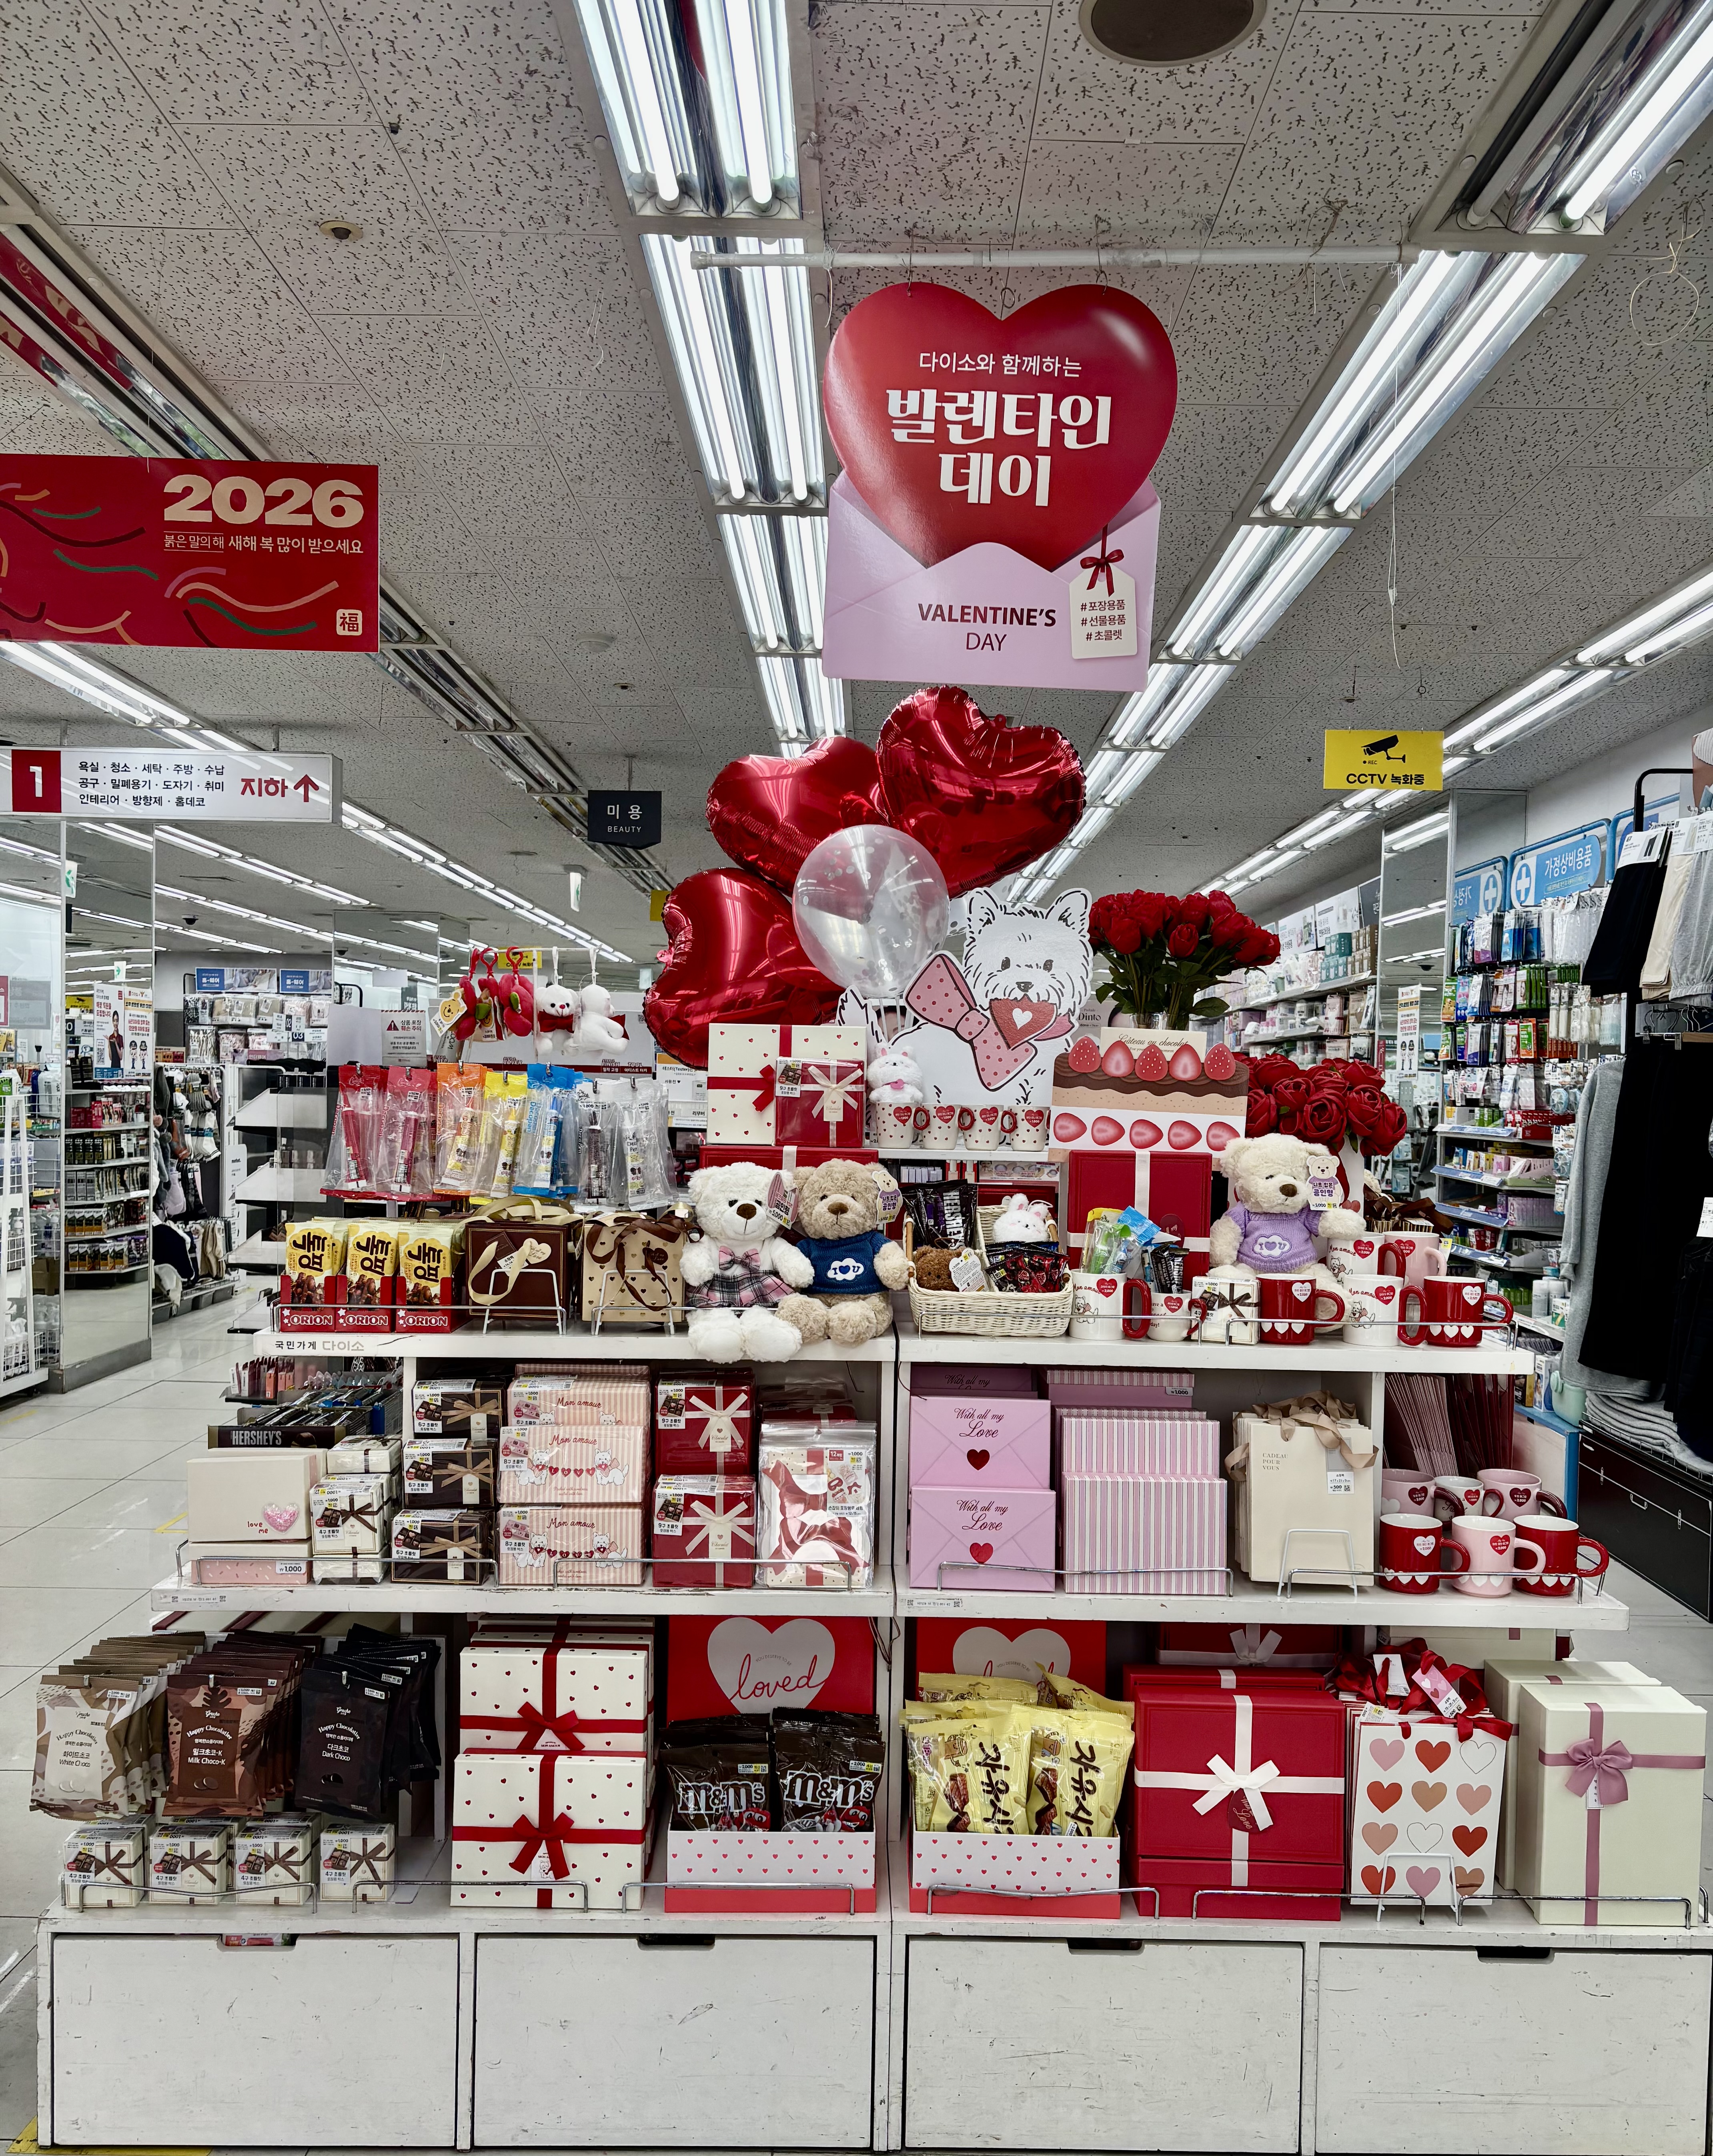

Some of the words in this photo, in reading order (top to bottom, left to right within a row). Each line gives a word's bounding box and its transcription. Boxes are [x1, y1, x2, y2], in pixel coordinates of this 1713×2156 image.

[920, 353, 995, 374] 다이소와
[1002, 354, 1082, 377] 함께하는
[886, 388, 1112, 450] 발렌타인
[939, 452, 1052, 506] 데이
[164, 474, 364, 528] 2026
[164, 534, 187, 548] 붉은
[189, 534, 210, 549] 말의
[212, 535, 224, 549] 해
[229, 535, 256, 552] 새해
[260, 536, 274, 552] 복
[277, 537, 305, 553] 많이
[309, 538, 364, 554] 받으세요
[340, 613, 359, 632] 福
[918, 603, 1056, 627] VALENTINE'S
[966, 633, 1007, 652] DAY
[79, 761, 99, 773] 욕실
[110, 762, 131, 773] 청소
[142, 763, 162, 775] 세탁
[172, 764, 193, 775] 주방
[204, 764, 224, 776] 수납
[29, 766, 43, 797] 1
[78, 778, 99, 789] 공구
[110, 779, 152, 791] 밀폐용기
[162, 779, 193, 791] 도자기
[204, 780, 224, 792] 취미
[1346, 774, 1387, 784] CCTV
[1390, 774, 1424, 785] 녹화중
[241, 777, 287, 798] 지하
[79, 793, 120, 806] 인테리어
[132, 795, 162, 807] 방향제
[174, 796, 205, 807] 홈데코
[607, 804, 642, 820] 미용
[1545, 845, 1591, 878] 가정상비용품
[1079, 1013, 1101, 1021] Dinto
[1119, 1034, 1145, 1045] Gâteau
[1159, 1037, 1188, 1047] chocolat
[527, 1101, 536, 1133] Decopen
[1313, 1189, 1334, 1197] 곰인형
[775, 1199, 790, 1216] 곰인형
[883, 1201, 897, 1211] 곰인형
[769, 1210, 783, 1221] ₩5,000
[293, 1232, 327, 1272] 톡핑
[356, 1235, 391, 1276] 톡핑
[1329, 1245, 1338, 1253] Mon
[408, 1242, 443, 1283] 톡핑
[290, 1315, 333, 1325] ORION
[346, 1315, 388, 1326] ORION
[405, 1316, 448, 1326] ORION
[275, 1341, 316, 1350] 국민가게
[322, 1341, 365, 1351] 다이소
[945, 1374, 965, 1385] With
[966, 1375, 976, 1385] all
[978, 1378, 990, 1387] my
[555, 1397, 575, 1407] Mon
[954, 1408, 975, 1420] With
[977, 1409, 988, 1420] all
[991, 1413, 1004, 1423] my
[959, 1421, 999, 1438] Love
[549, 1434, 571, 1445] Mon
[957, 1499, 978, 1512] With
[980, 1501, 992, 1512] all
[994, 1505, 1008, 1515] my
[547, 1517, 568, 1529] Mon
[571, 1521, 595, 1529] amour
[962, 1512, 1003, 1531] Love
[729, 1654, 825, 1700] loved
[56, 1731, 74, 1741] Happy
[75, 1729, 98, 1744] Chocolatier
[186, 1727, 204, 1737] Happy
[205, 1725, 232, 1740] Chocolatier
[318, 1724, 335, 1733] Happy
[336, 1723, 360, 1740] Chocolatier
[63, 1751, 90, 1759] 화이트초코
[193, 1748, 222, 1756] 밀크초코-K
[327, 1744, 349, 1753] 다크초코
[335, 1753, 351, 1761] Choco
[1233, 1806, 1253, 1830] Love
